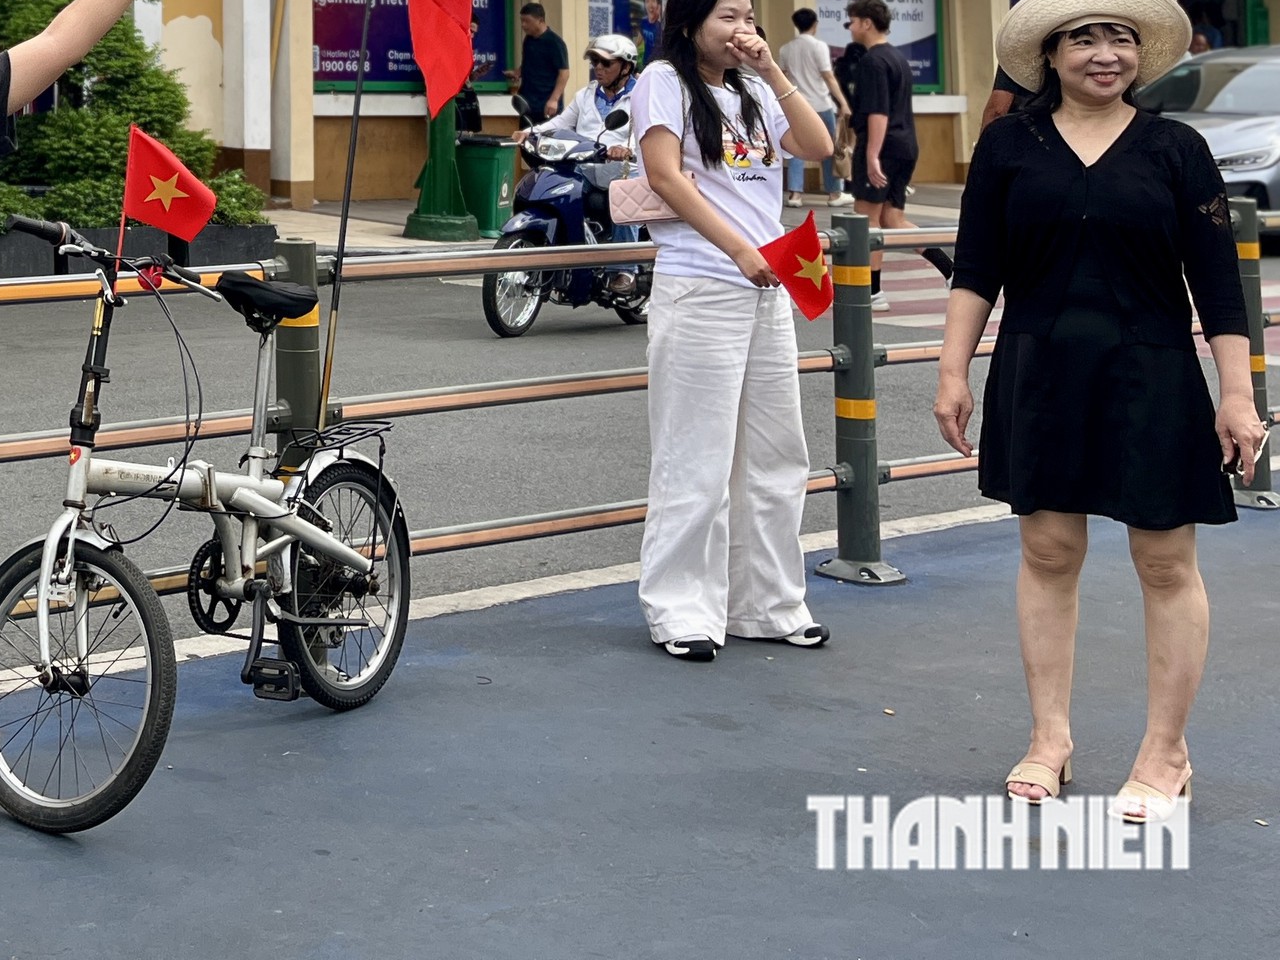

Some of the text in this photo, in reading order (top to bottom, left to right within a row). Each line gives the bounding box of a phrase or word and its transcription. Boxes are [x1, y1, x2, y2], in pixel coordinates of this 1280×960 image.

[818, 6, 842, 22] hàng
[901, 8, 924, 22] nhất!
[326, 49, 348, 59] Hotline
[387, 49, 411, 62] Chạm
[321, 60, 371, 73] 1900 668
